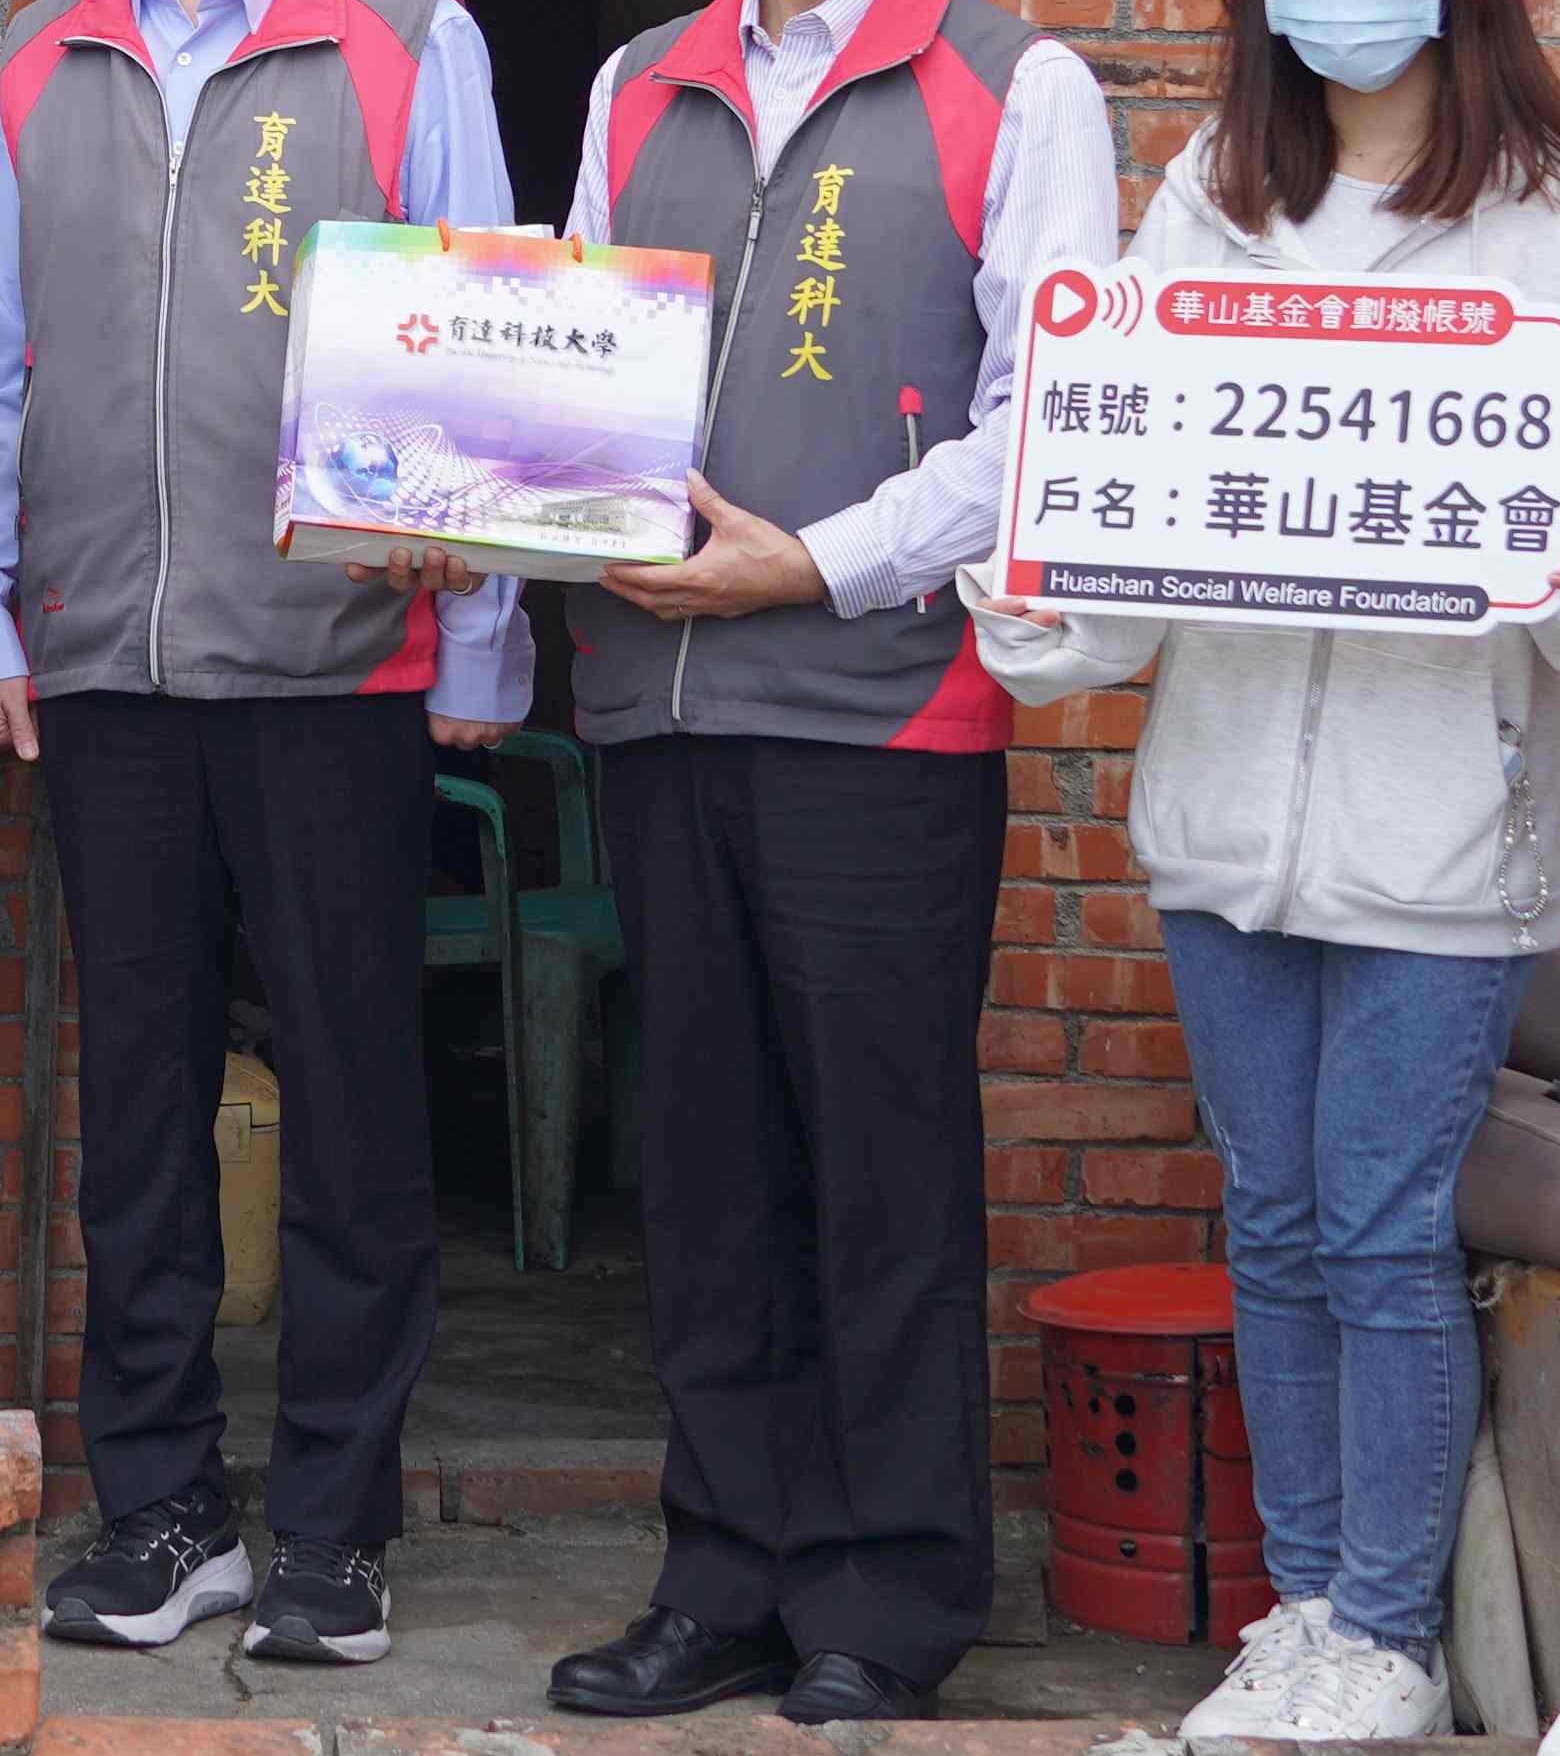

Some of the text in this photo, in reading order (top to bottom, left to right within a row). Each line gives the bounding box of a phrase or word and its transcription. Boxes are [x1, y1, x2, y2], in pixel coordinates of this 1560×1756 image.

[240, 111, 296, 317] 育達科大
[781, 164, 854, 381] 育達科大
[1170, 290, 1497, 336] 華山基金會劃撥帳號
[448, 315, 618, 359] 育達科技大學
[1049, 569, 1477, 616] Huashan Social Welfare Foundation
